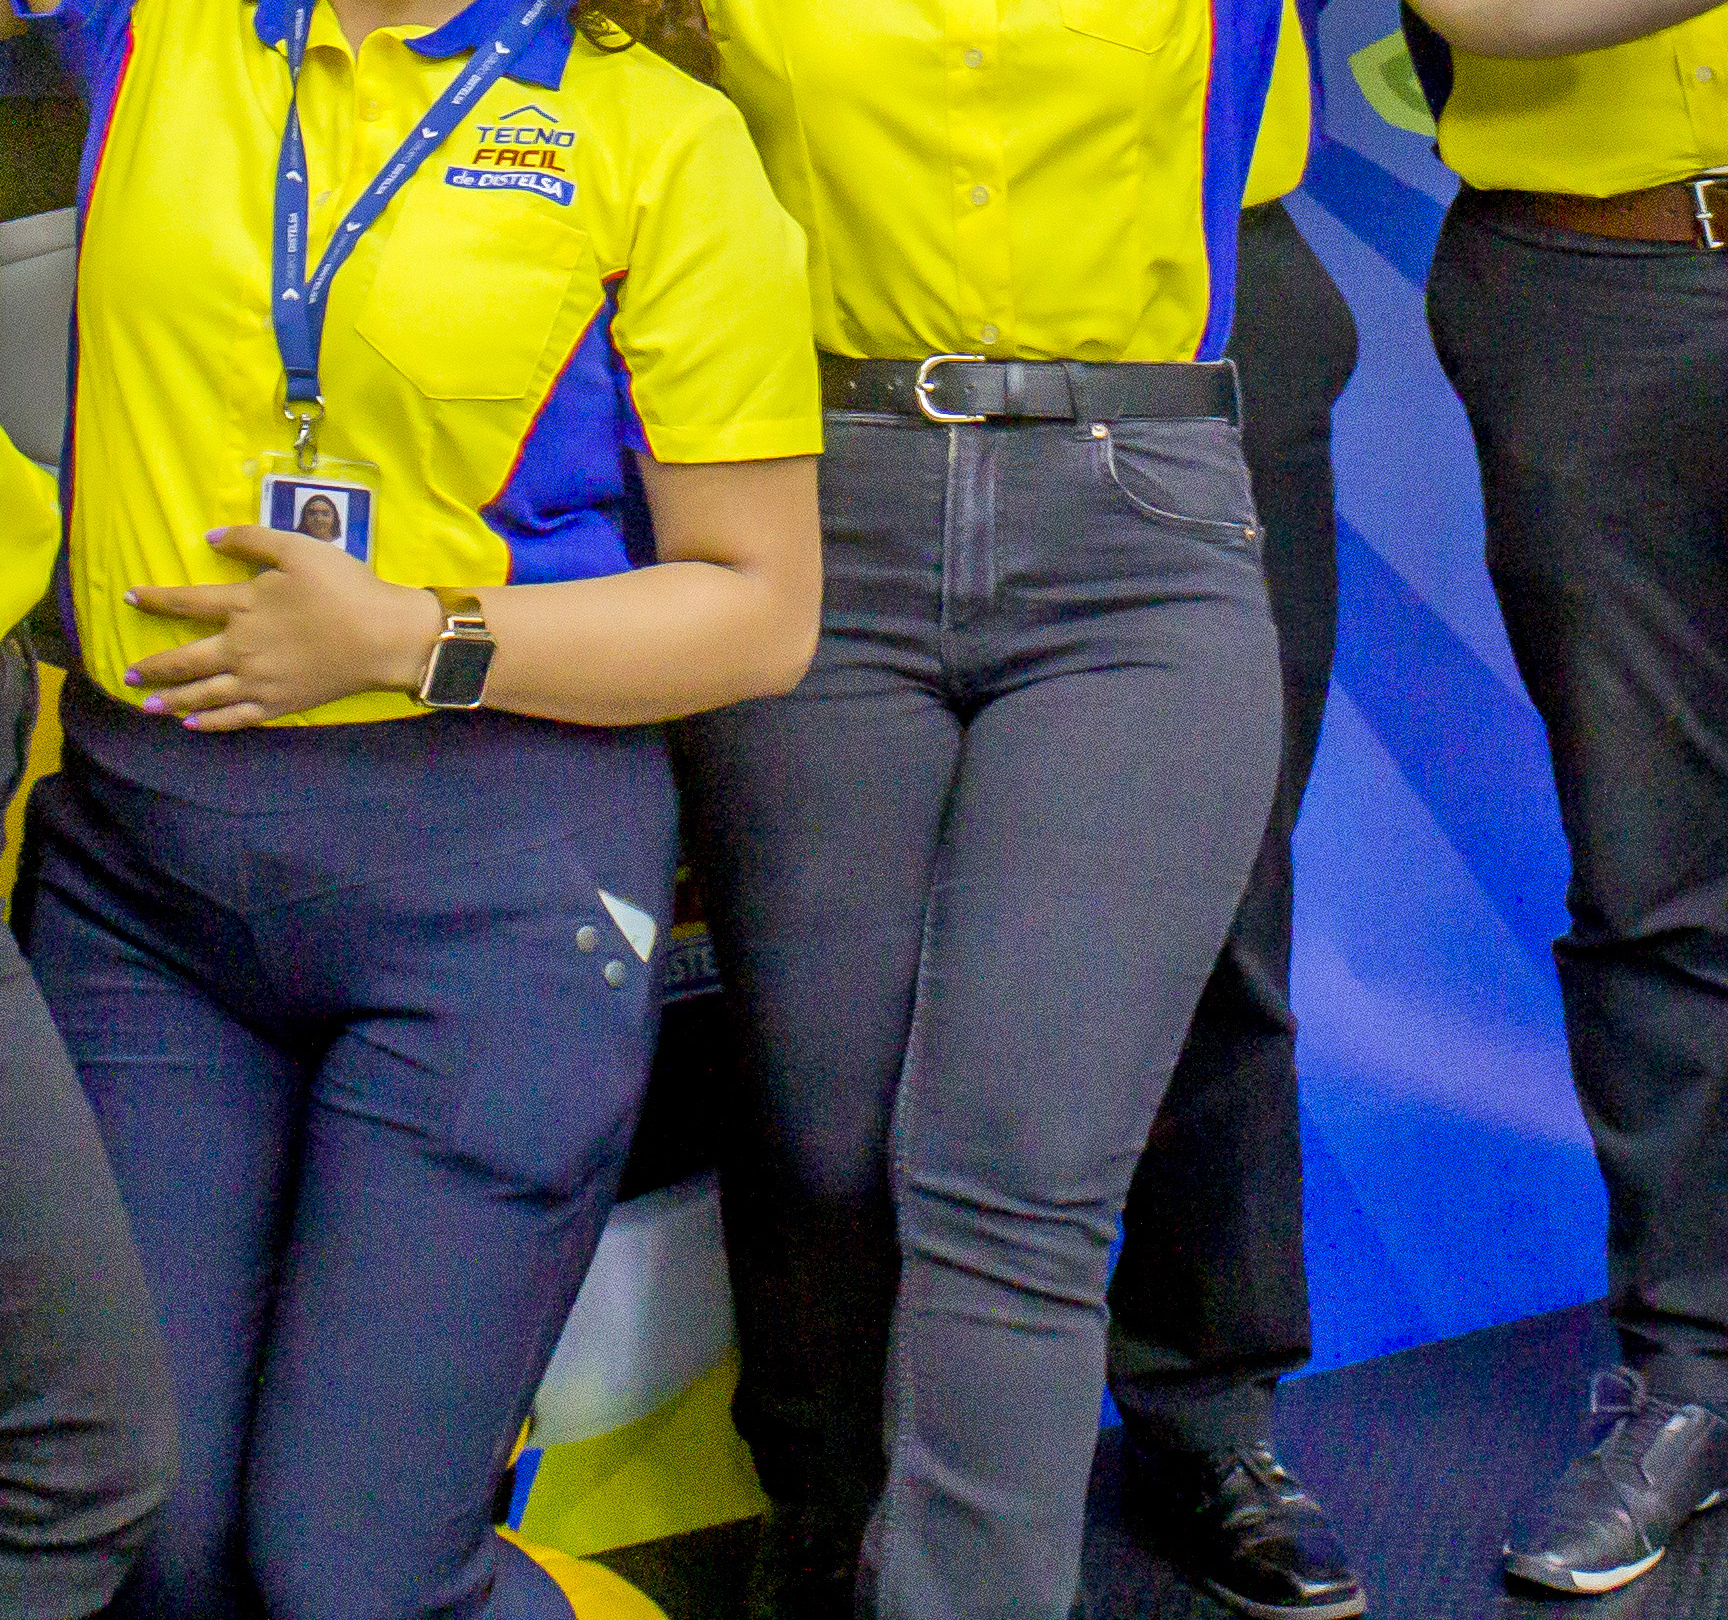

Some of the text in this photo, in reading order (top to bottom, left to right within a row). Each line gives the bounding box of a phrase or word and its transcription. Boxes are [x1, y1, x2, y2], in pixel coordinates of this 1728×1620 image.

[476, 126, 575, 147] TECNO
[472, 148, 566, 173] FACIL
[453, 170, 563, 199] de DISTELSA
